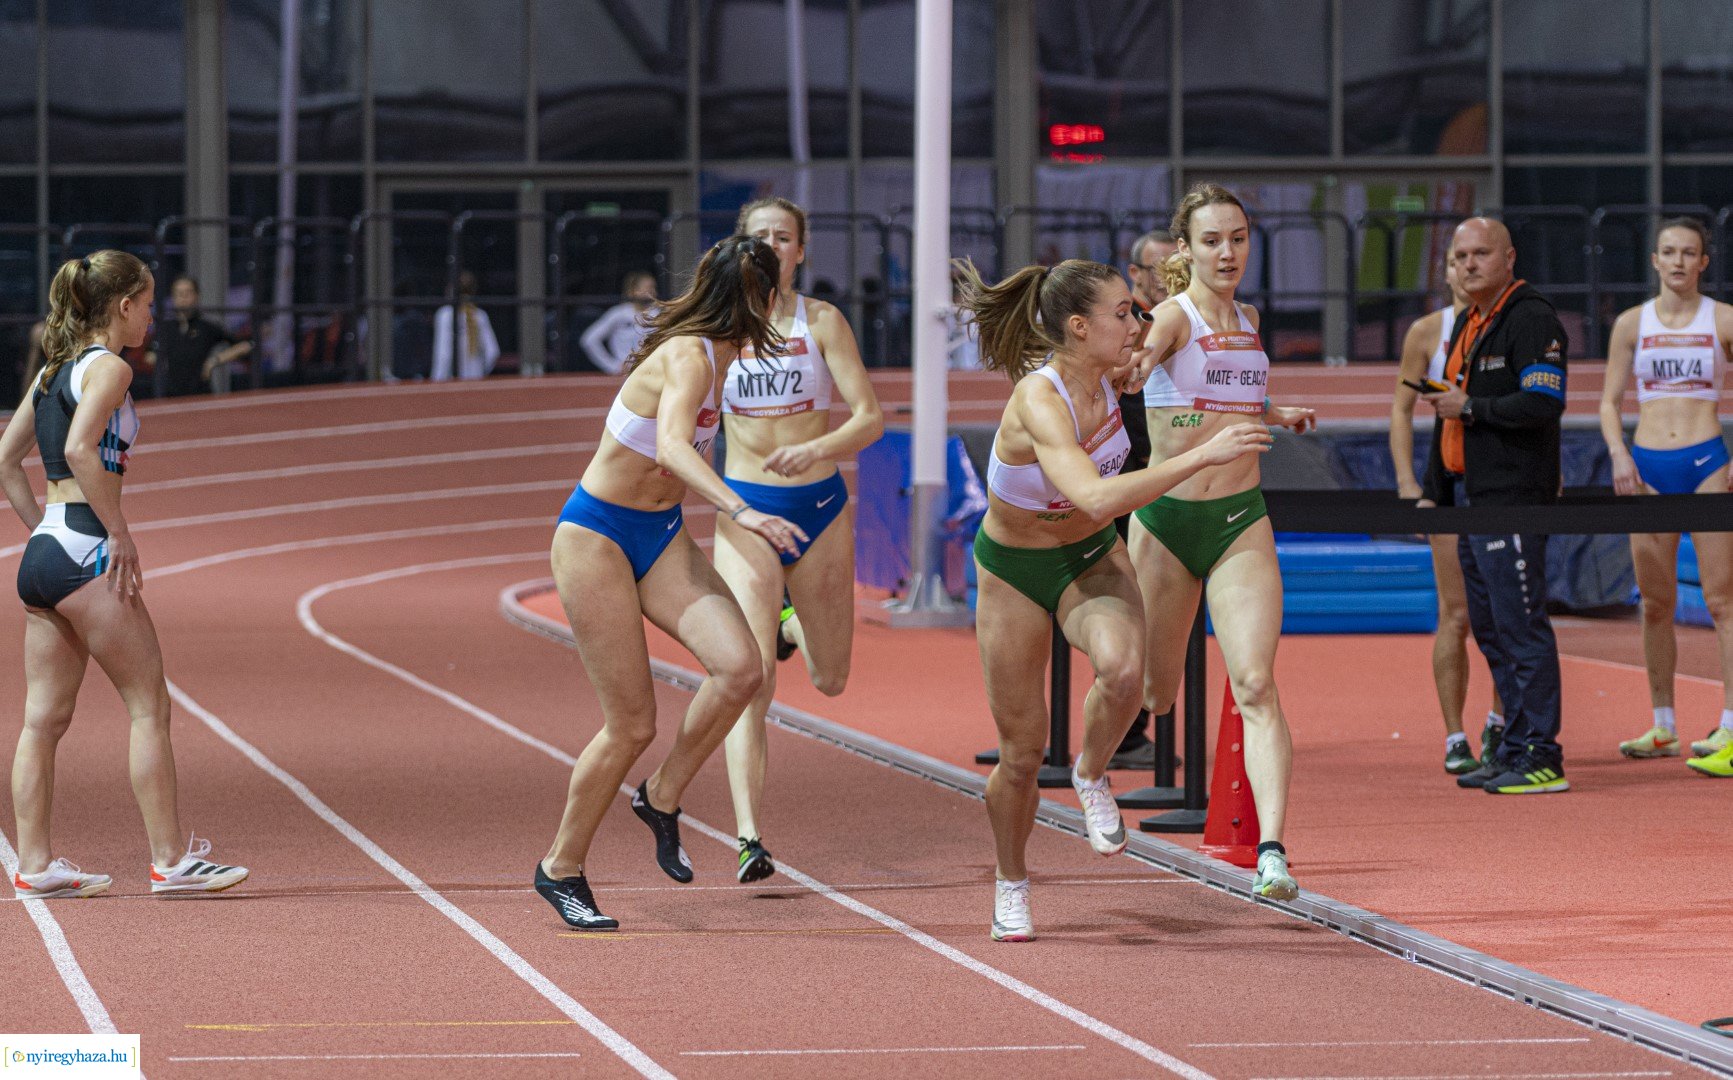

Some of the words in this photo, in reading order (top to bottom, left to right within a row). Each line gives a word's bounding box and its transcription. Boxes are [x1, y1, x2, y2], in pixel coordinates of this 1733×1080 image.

[1206, 369, 1233, 385] MATE
[1653, 359, 1702, 378] MTK/4
[738, 370, 803, 398] MTK/2
[1521, 371, 1562, 391] REFEREE
[1205, 402, 1255, 413] NYÍREGYHÁZA
